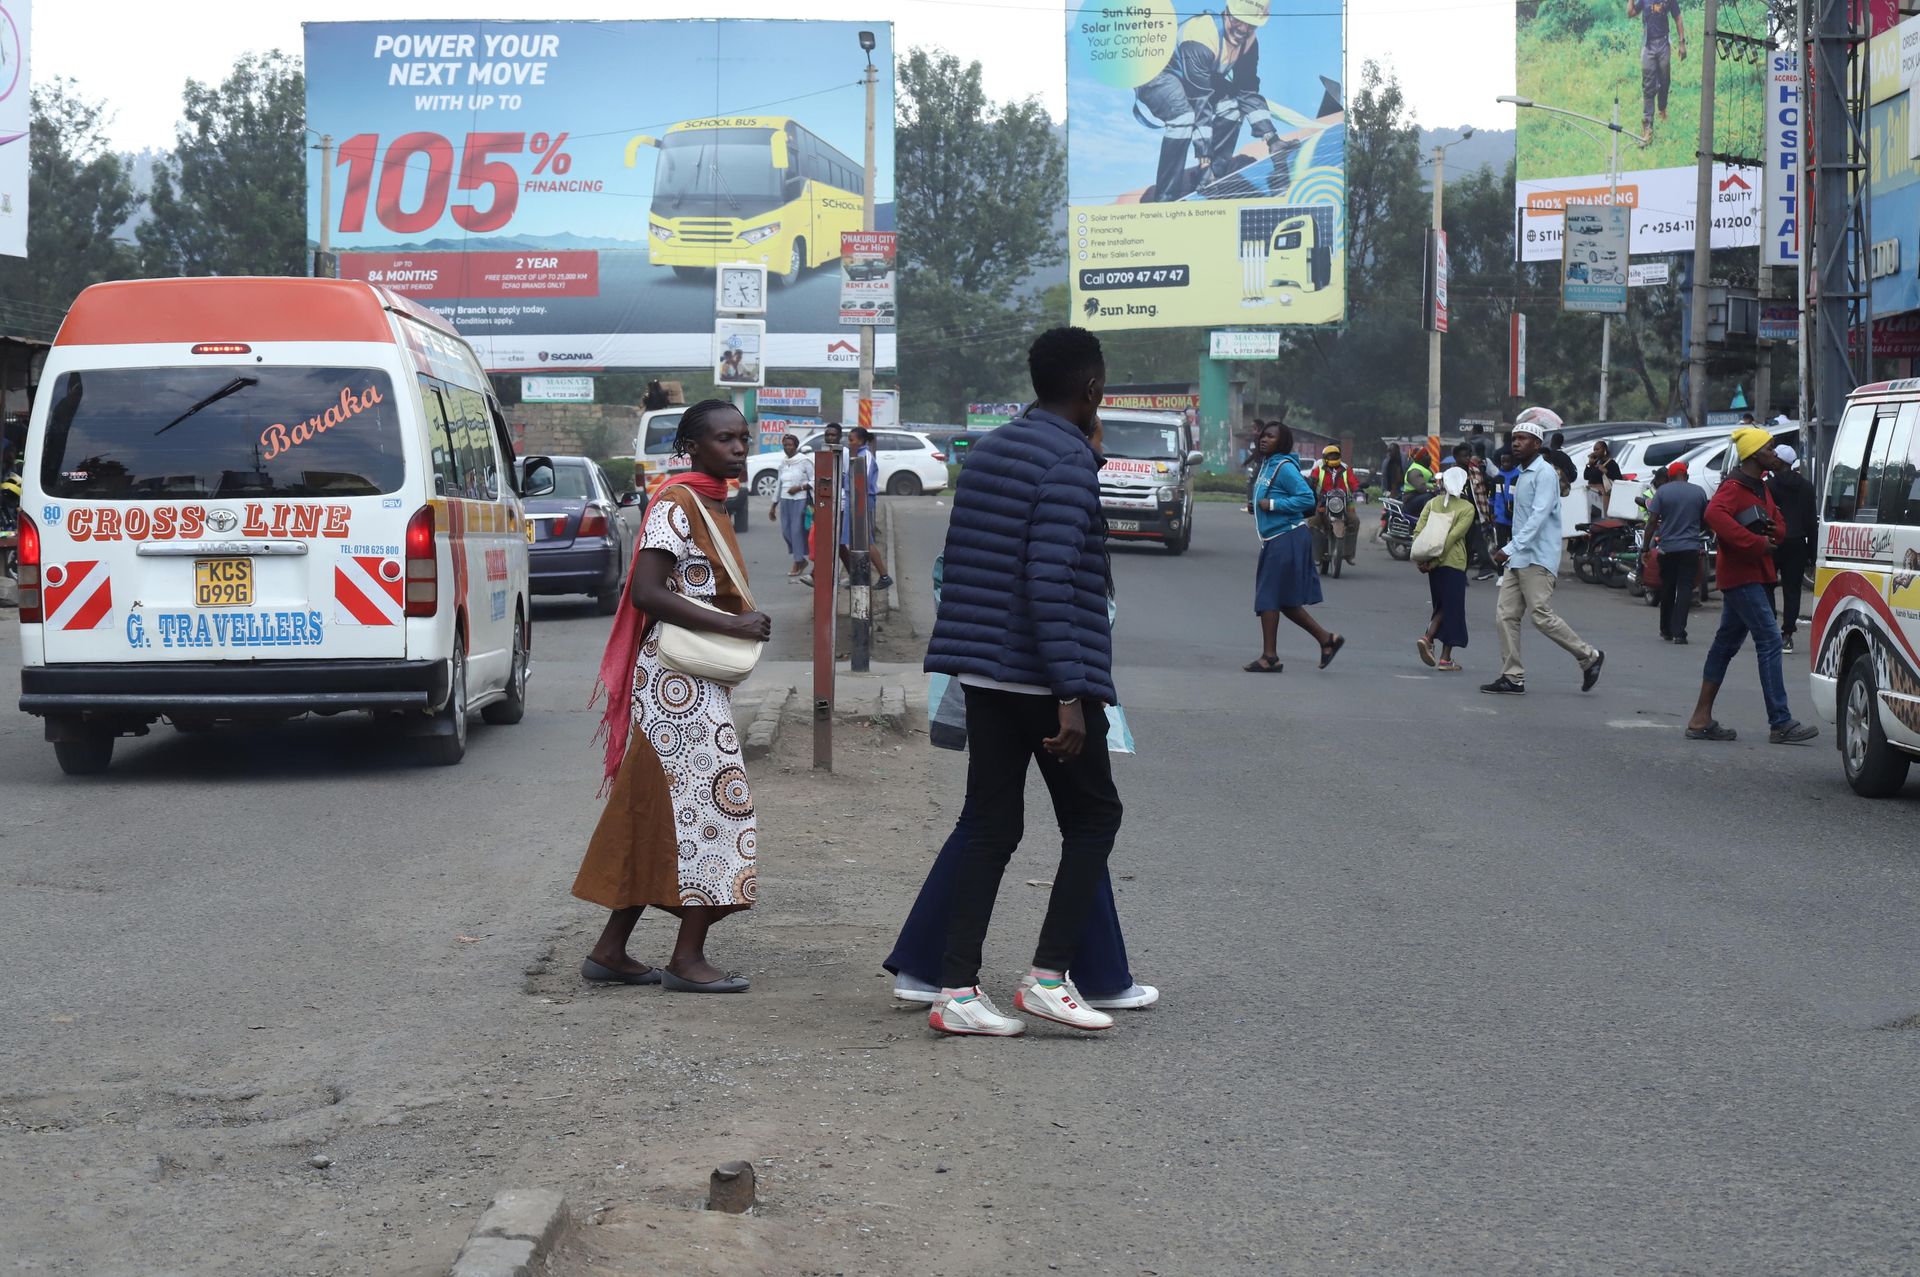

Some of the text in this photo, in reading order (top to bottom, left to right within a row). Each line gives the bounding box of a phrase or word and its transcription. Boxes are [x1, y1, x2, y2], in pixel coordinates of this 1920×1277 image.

[1102, 7, 1151, 18] Sun King
[1081, 23, 1111, 33] Solar
[1114, 19, 1164, 32] Inverters
[374, 34, 560, 58] POWER YOUR
[1088, 33, 1167, 48] Your Complete
[1903, 31, 1918, 50] ORDER
[1091, 47, 1164, 61] Solar Solution
[389, 62, 548, 86] NEXT MOVE
[415, 94, 522, 111] WITH UP TO
[684, 118, 757, 129] SCHOOL BUS
[1778, 85, 1799, 259] HOSPITAL
[336, 131, 572, 234] 105%
[524, 180, 603, 193] FINANCING
[1531, 191, 1634, 212] 100% FINANCNG
[1718, 191, 1753, 203] EQUITY
[822, 198, 856, 210] SCHOOL
[1090, 214, 1109, 222] Solar
[1165, 210, 1187, 219] Lights
[1195, 208, 1226, 217] Batteries
[1090, 226, 1123, 235] Financing
[847, 235, 897, 244] NAKURU CITY
[1107, 238, 1145, 246] Installation
[1110, 251, 1129, 259] Sales
[1130, 250, 1156, 258] Service
[515, 257, 559, 269] 2 YEAR
[368, 270, 439, 282] 84 MONTHS
[1084, 269, 1184, 285] Call 0709 47 47 47
[429, 306, 456, 316] Equity
[457, 306, 488, 314] Branch
[498, 307, 521, 316] apply
[522, 305, 548, 316] today.
[1100, 305, 1124, 316] sun
[455, 317, 493, 325] Conditions
[551, 352, 594, 361] SCANIA
[1111, 396, 1153, 408] JOMBAA
[1156, 395, 1193, 408] CHOMA
[261, 385, 383, 460] Baraka
[1101, 461, 1151, 474] OROLINE
[383, 500, 402, 508] PSV
[43, 506, 61, 520] 80
[67, 503, 352, 543] CROSS LINE
[1826, 525, 1874, 558] PRESTIGE
[340, 544, 399, 555] TEL: 0718 625 800
[210, 561, 248, 581] KCS
[200, 583, 248, 603] 099G
[127, 611, 324, 648] G. TRAVELLERS
